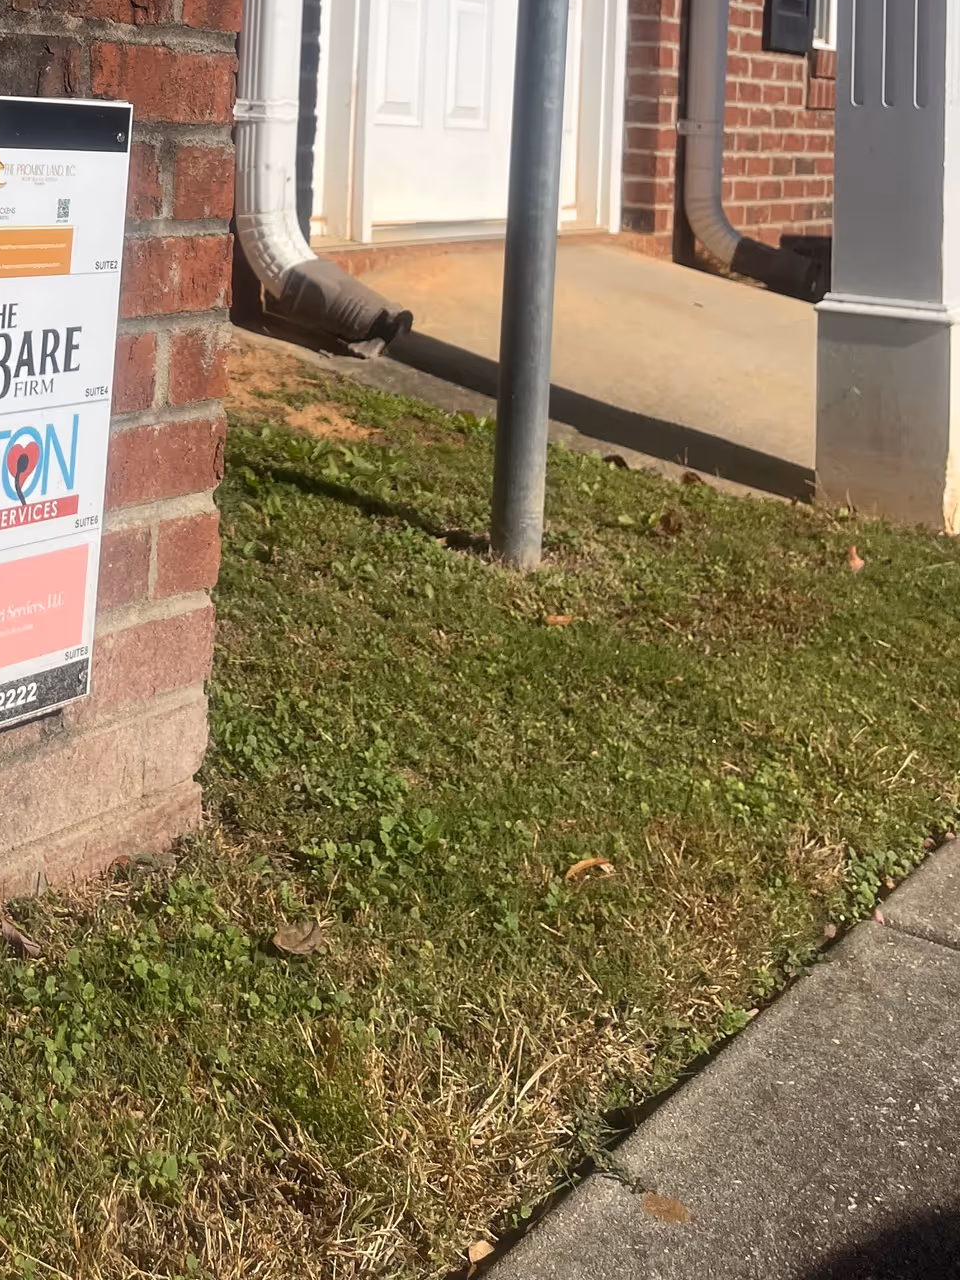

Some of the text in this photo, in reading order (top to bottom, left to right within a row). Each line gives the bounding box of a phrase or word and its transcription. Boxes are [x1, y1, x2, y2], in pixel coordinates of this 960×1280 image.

[95, 260, 118, 271] SUITE2
[13, 378, 55, 398] FIRM
[85, 386, 109, 398] SUITE4
